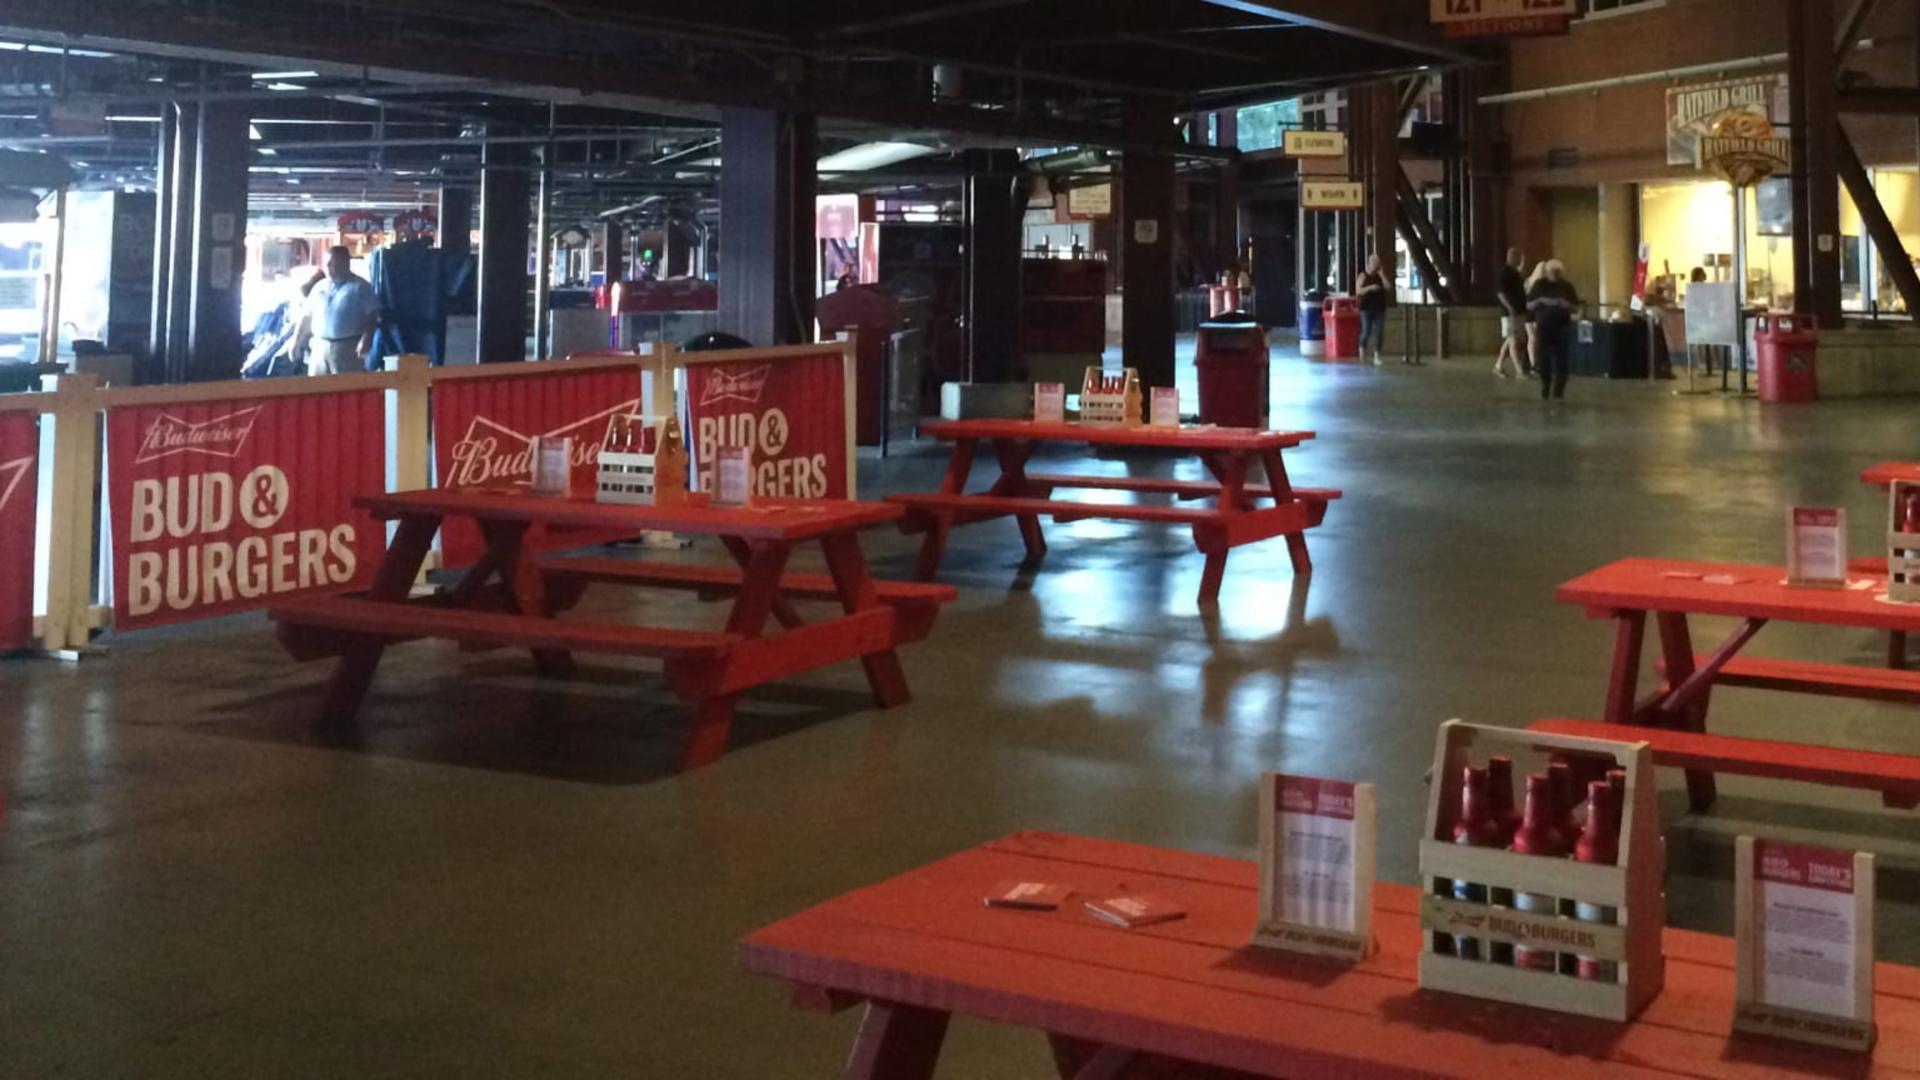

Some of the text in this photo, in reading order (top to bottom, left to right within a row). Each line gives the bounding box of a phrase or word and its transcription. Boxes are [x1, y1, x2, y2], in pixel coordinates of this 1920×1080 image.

[1731, 82, 1764, 107] GRILL
[145, 422, 249, 449] Budweiser
[451, 432, 600, 486] Budise
[129, 471, 233, 543] BUD
[128, 523, 357, 616] BURGERS
[1530, 922, 1596, 948] BURGERS
